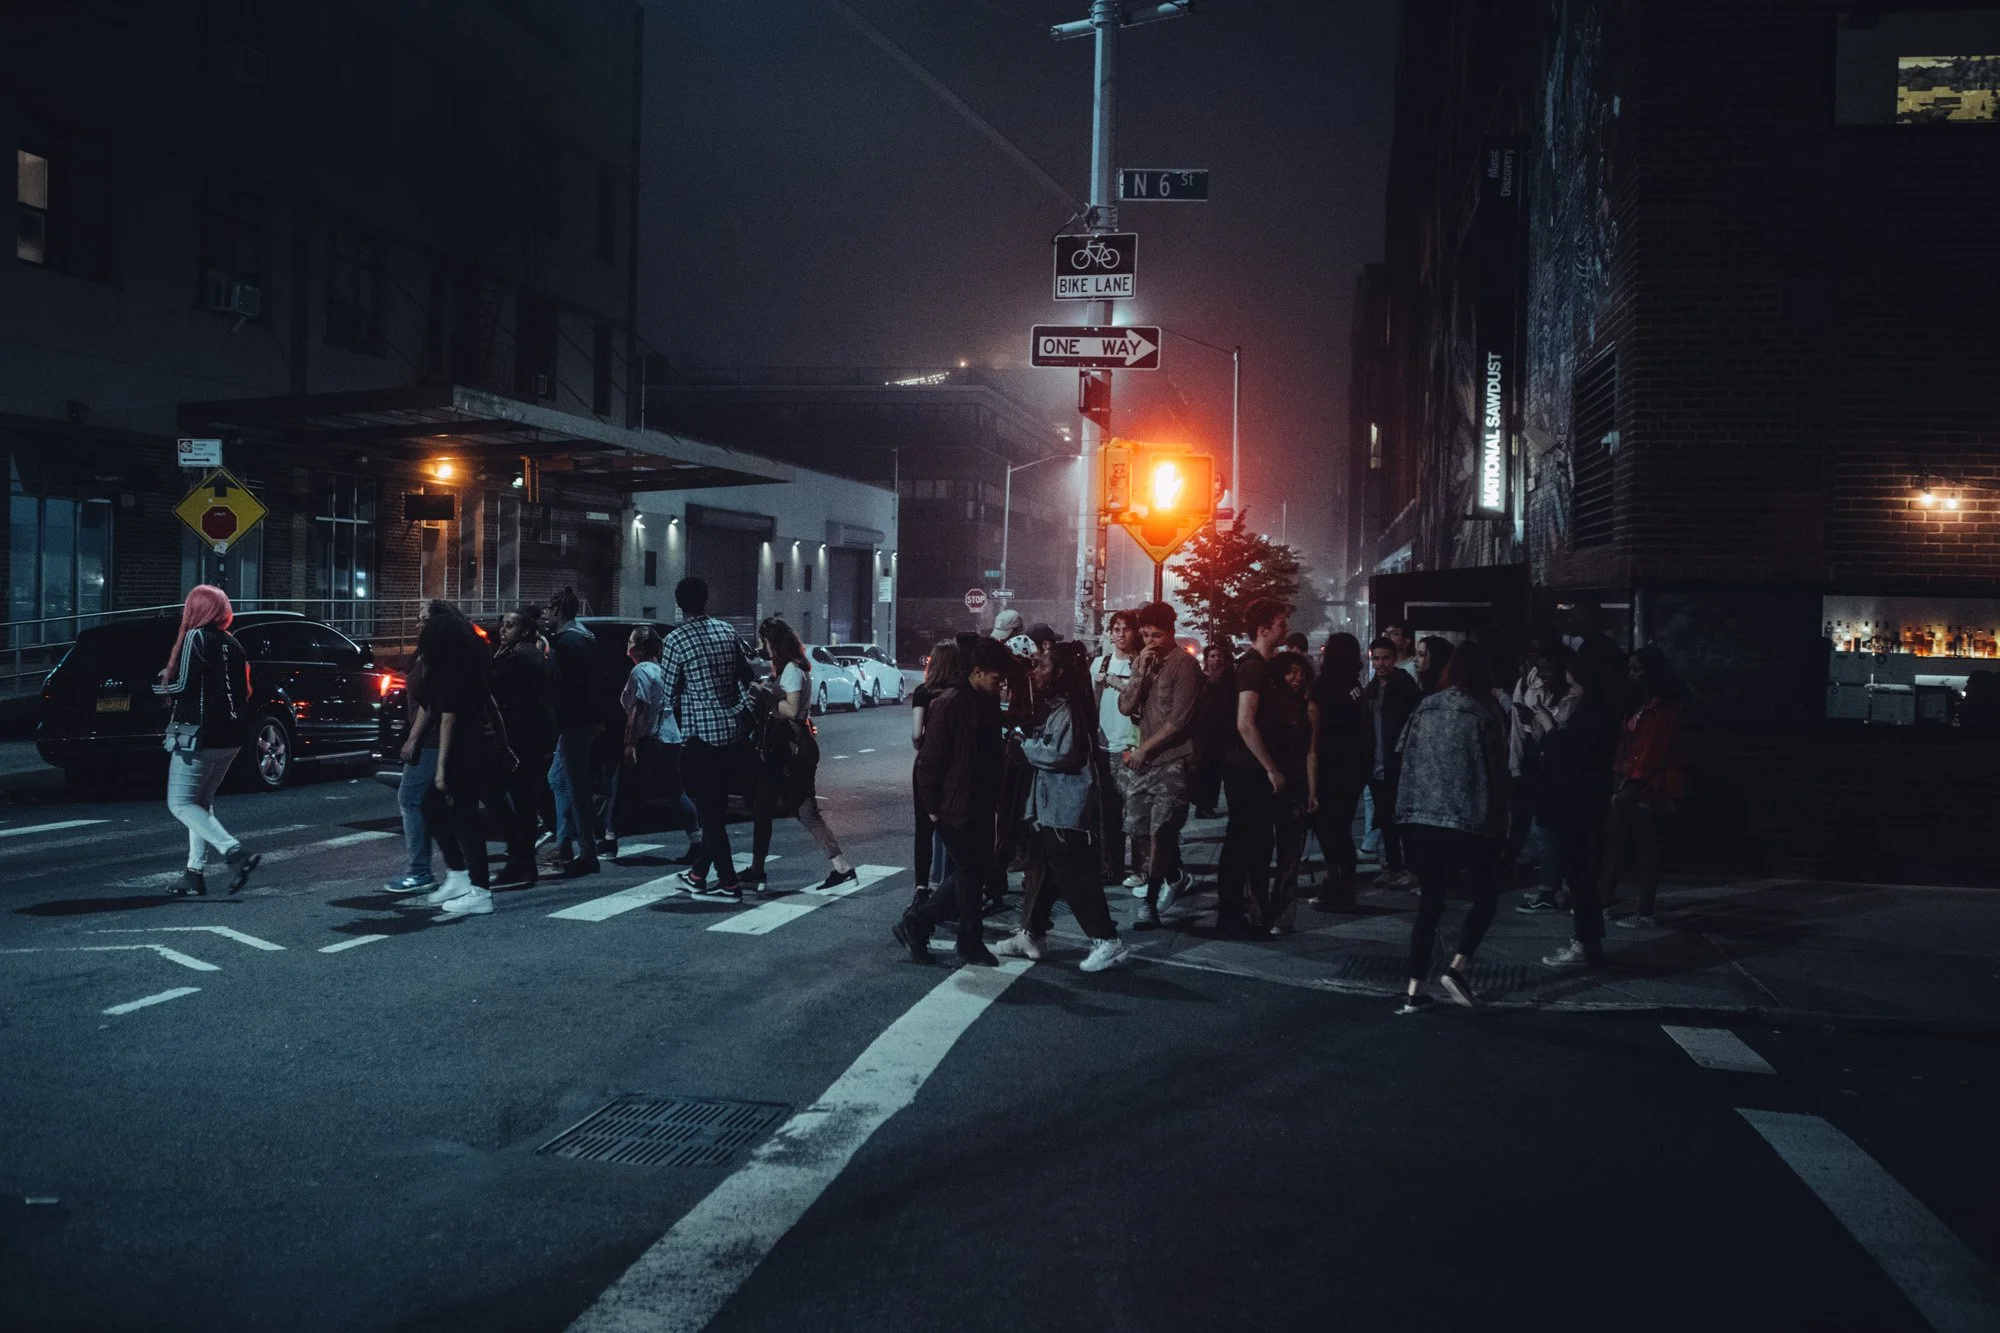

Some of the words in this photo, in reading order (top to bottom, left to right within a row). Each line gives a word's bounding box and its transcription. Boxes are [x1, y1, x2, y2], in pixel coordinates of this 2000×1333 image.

[1134, 173, 1147, 196] N
[1159, 173, 1170, 196] 6
[1180, 173, 1194, 187] St
[1059, 278, 1088, 293] BIKE
[1095, 277, 1130, 293] LANE
[1043, 338, 1080, 355] ONE
[1102, 339, 1143, 356] WAY
[1485, 352, 1501, 428] SAWDUST
[1483, 429, 1500, 508] NATIONAL
[966, 595, 986, 604] STOP
